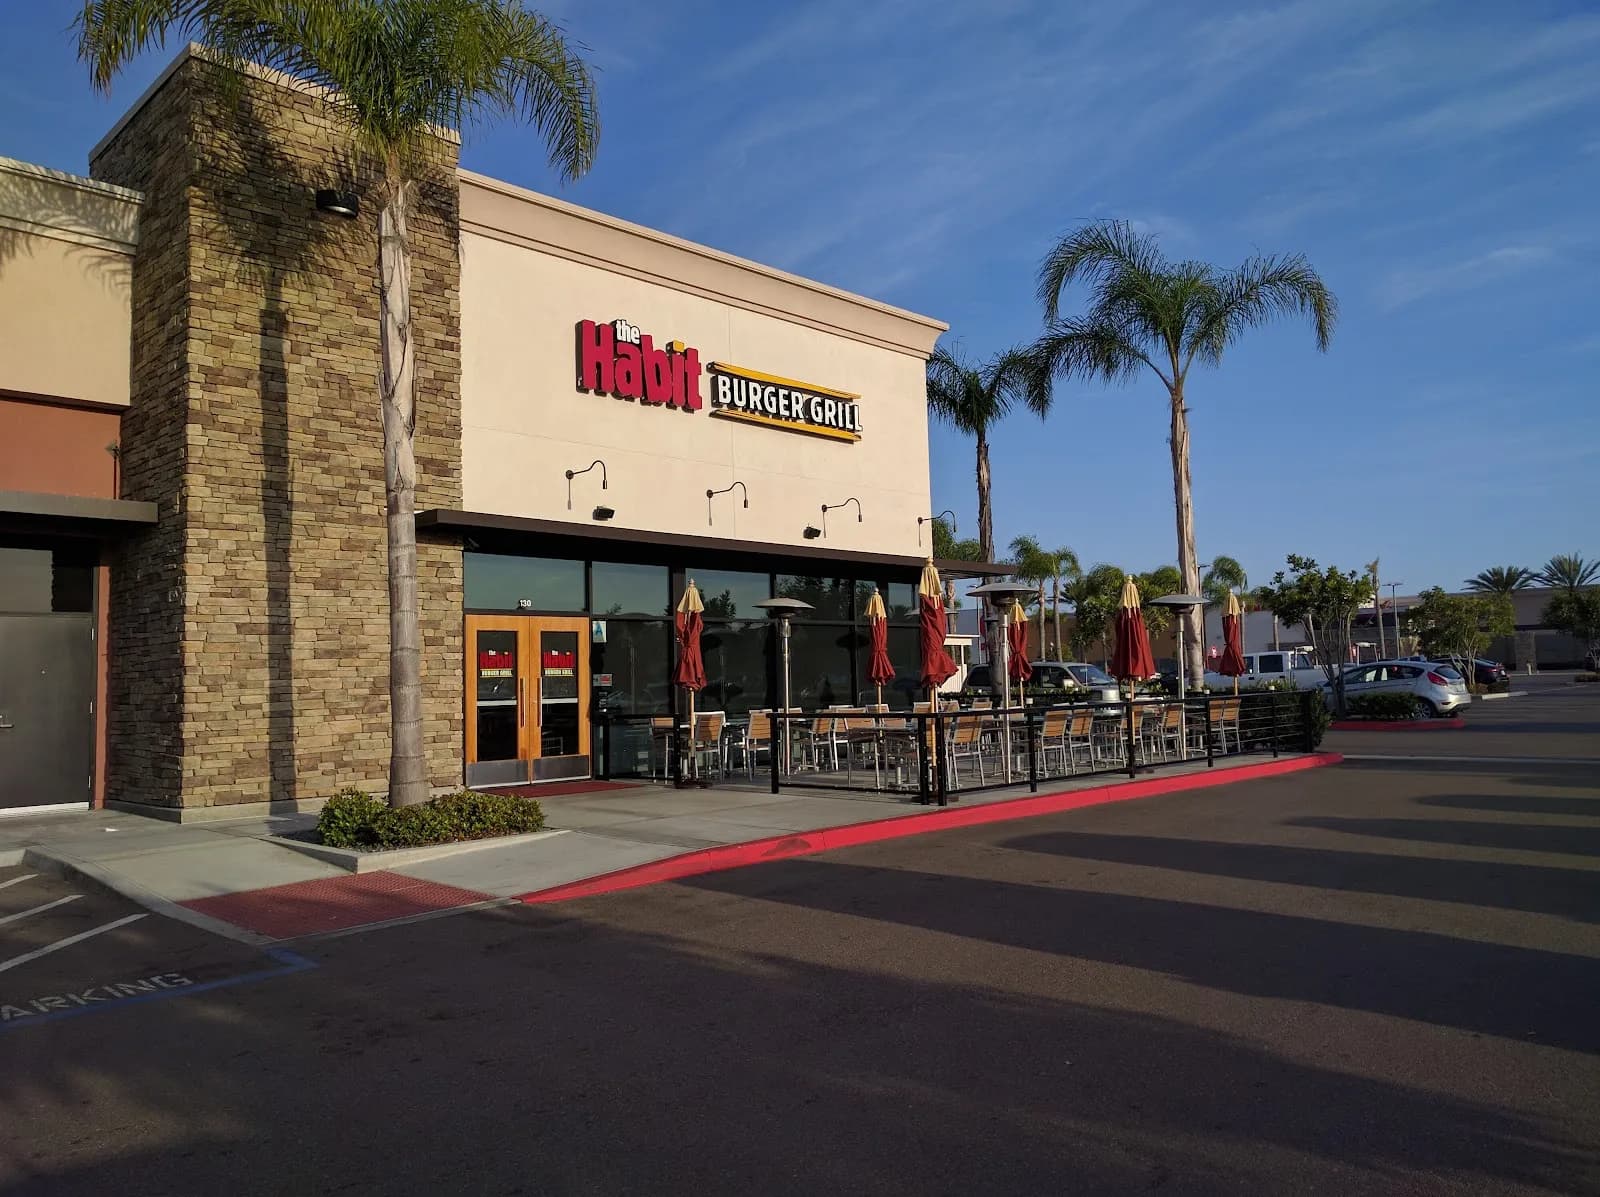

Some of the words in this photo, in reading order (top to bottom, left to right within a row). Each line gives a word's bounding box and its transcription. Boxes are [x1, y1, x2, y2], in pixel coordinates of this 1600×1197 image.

[614, 319, 641, 344] the
[578, 319, 702, 411] Habit
[716, 375, 804, 419] BURGER
[810, 396, 863, 432] GRILL
[519, 599, 532, 607] 130
